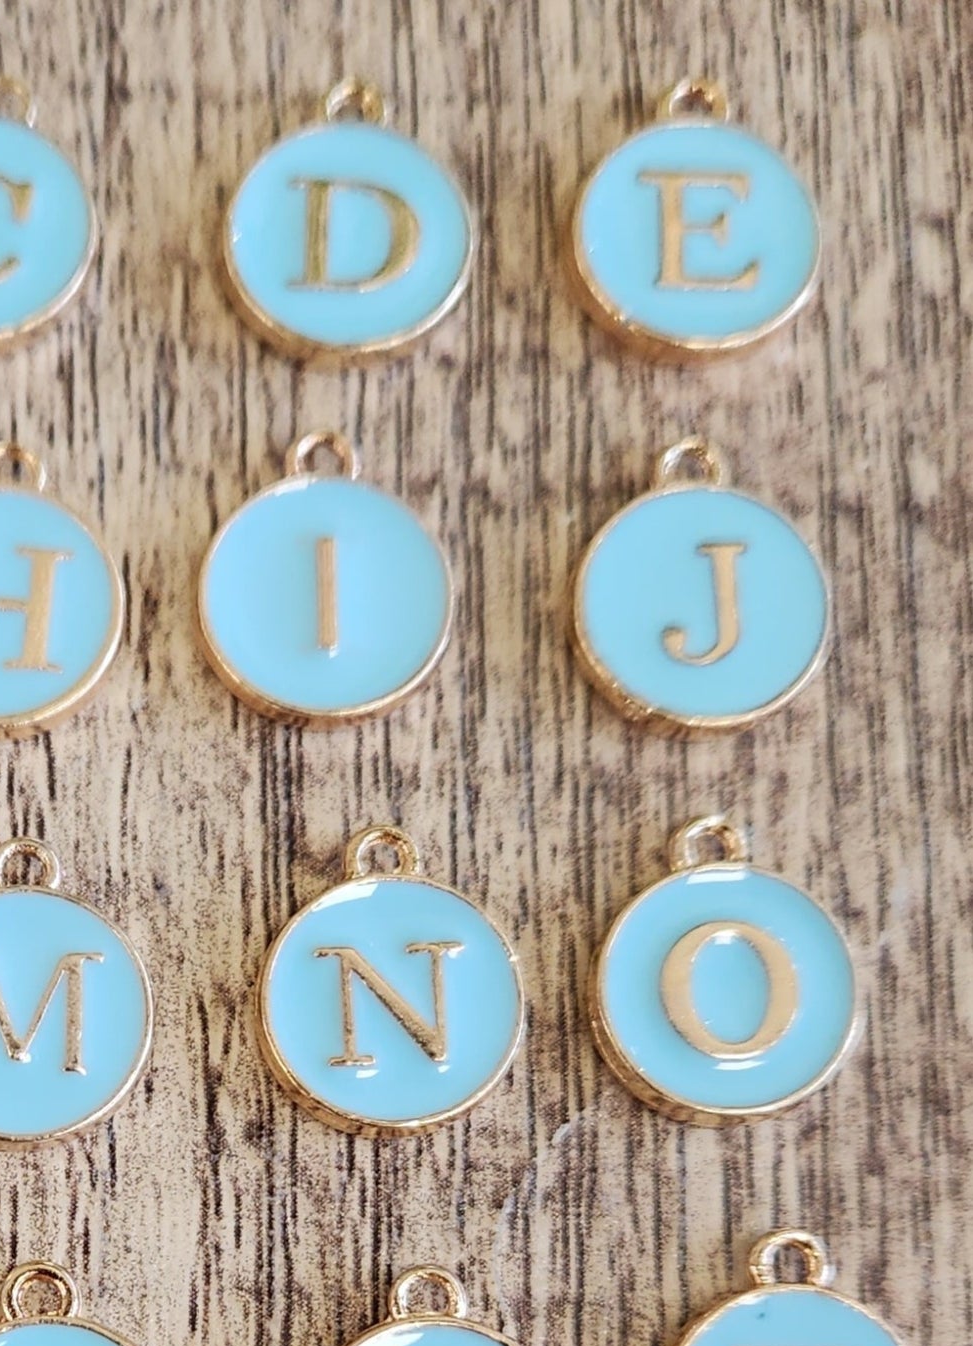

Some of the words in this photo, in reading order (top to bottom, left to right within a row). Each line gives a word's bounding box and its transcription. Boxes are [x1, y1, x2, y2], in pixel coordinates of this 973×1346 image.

[287, 178, 418, 292] D
[639, 171, 760, 292] E
[317, 537, 337, 653] I
[662, 538, 748, 667] J
[313, 940, 464, 1071] N
[661, 921, 797, 1056] O
